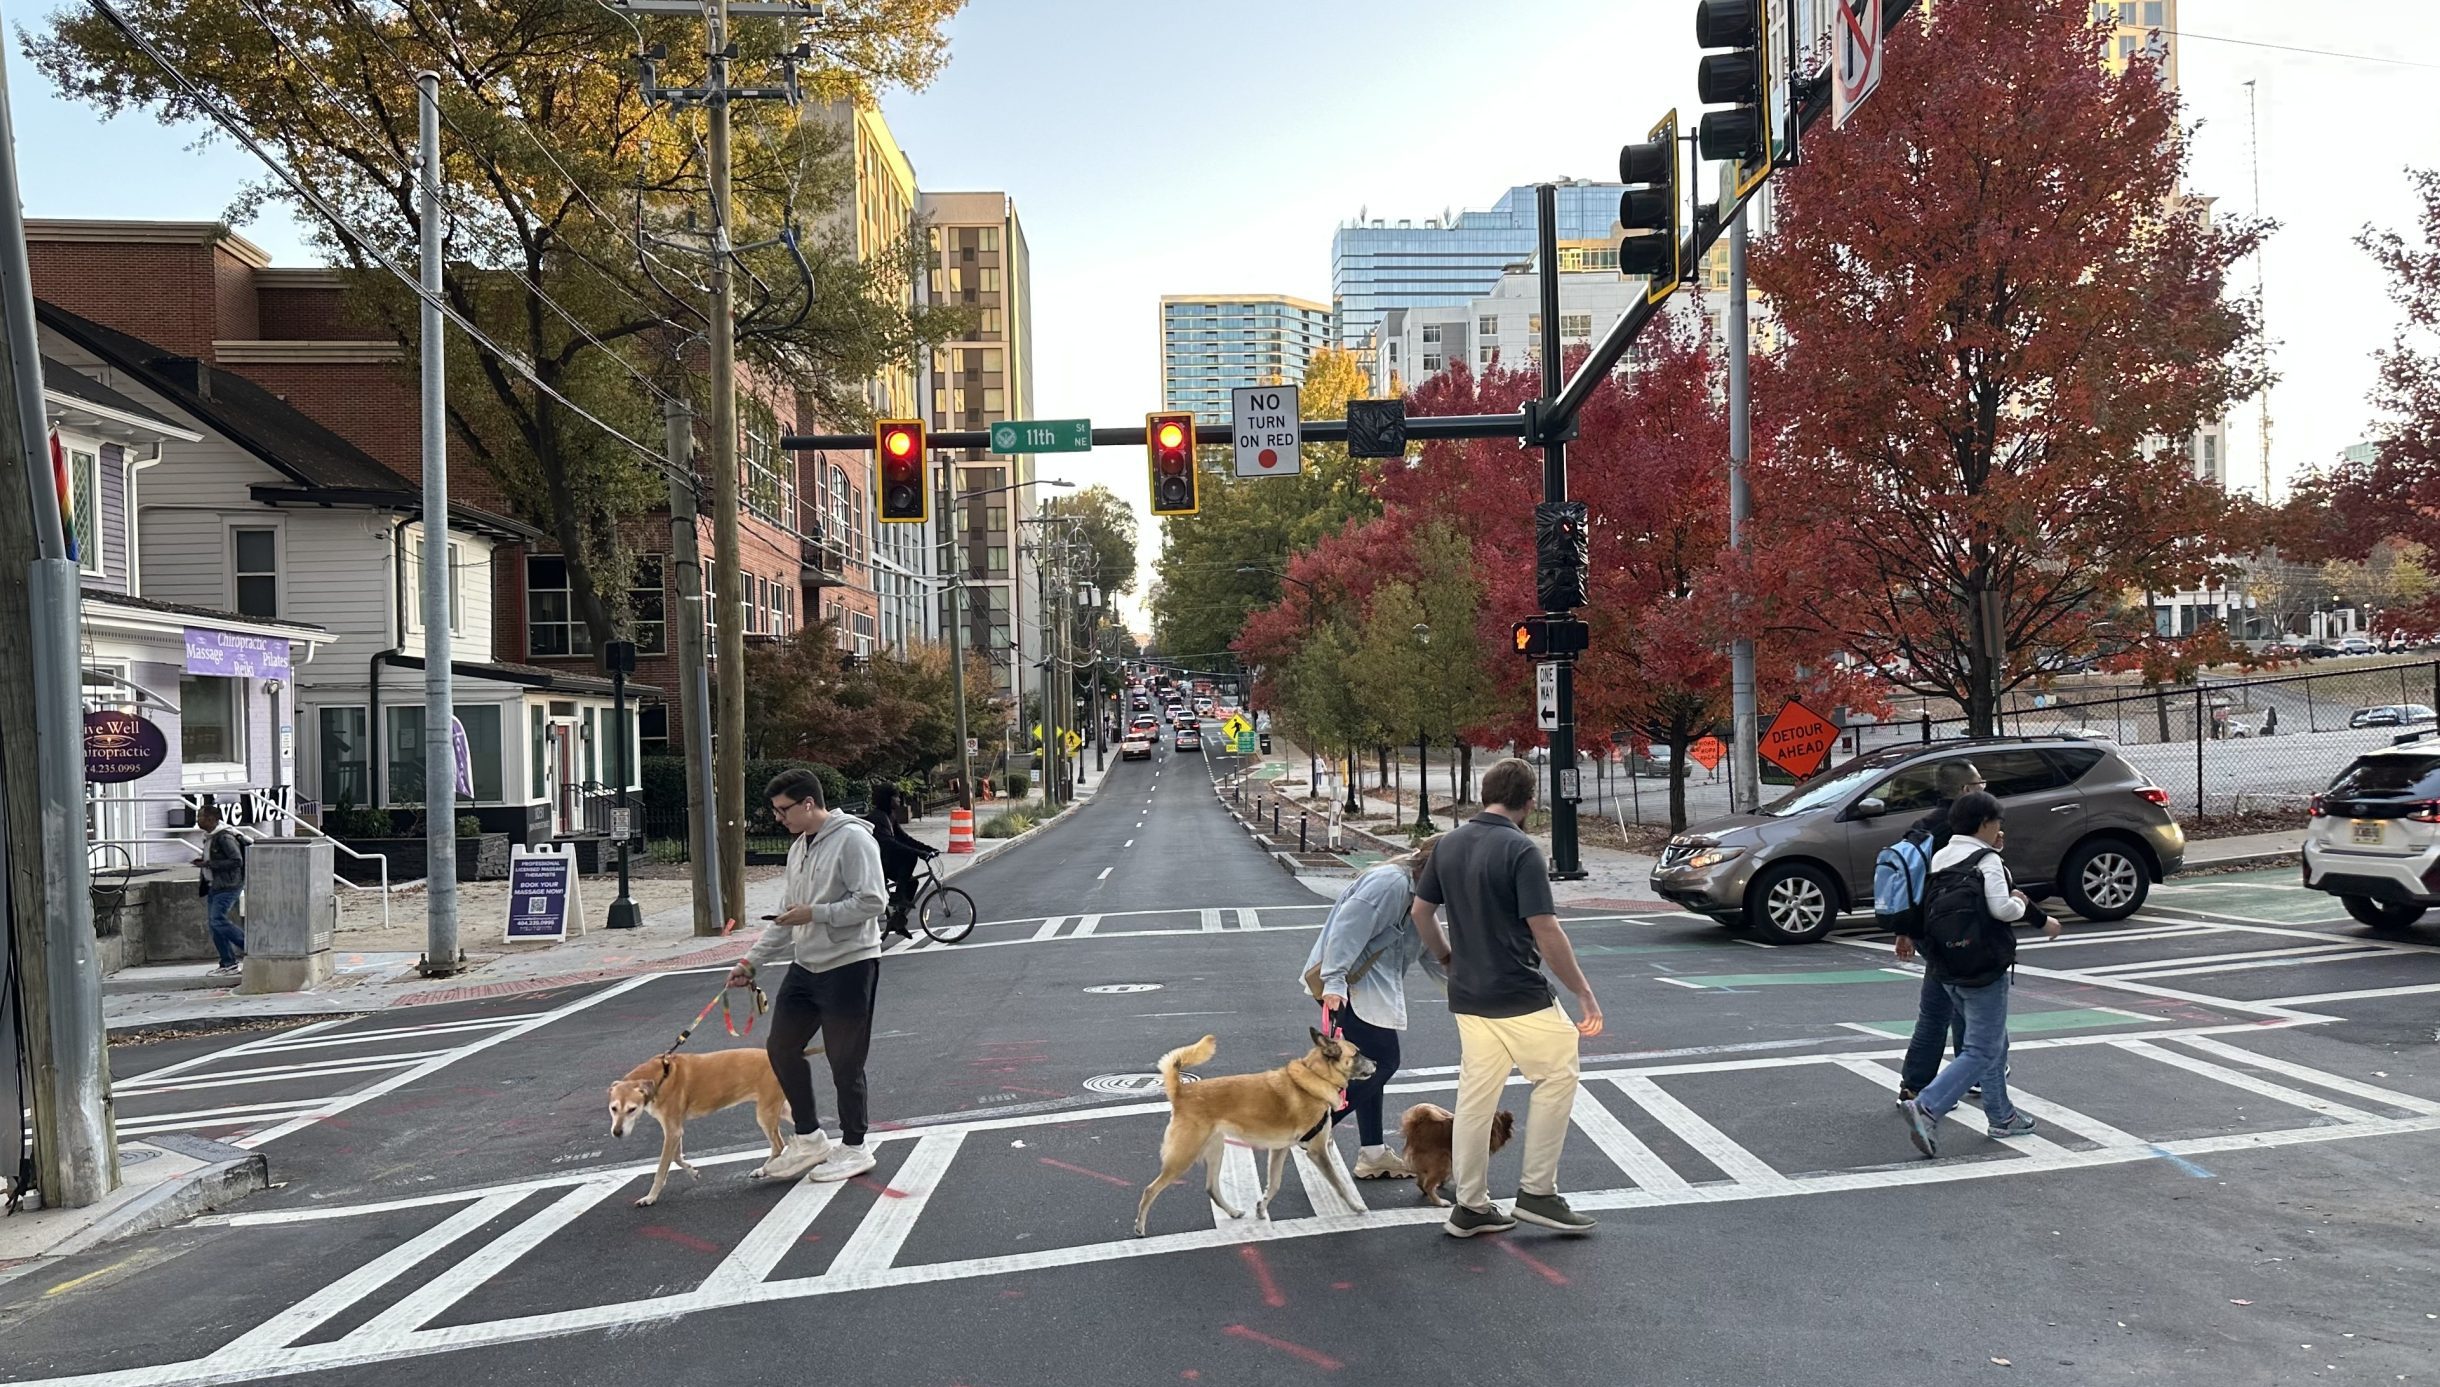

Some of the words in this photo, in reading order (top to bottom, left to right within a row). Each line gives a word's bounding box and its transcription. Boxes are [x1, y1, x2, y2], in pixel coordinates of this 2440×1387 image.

[1250, 393, 1280, 411] NO
[1247, 415, 1286, 430] TURN
[1026, 428, 1055, 446] 11th
[1075, 423, 1085, 433] St
[1074, 437, 1087, 446] NE
[1240, 434, 1259, 448] ON
[1267, 433, 1294, 447] RED
[217, 632, 267, 653] Chiropractic
[186, 643, 224, 665] Massage
[262, 651, 289, 668] Pilates
[233, 661, 255, 677] Reiki
[1540, 667, 1554, 682] ONE
[1540, 686, 1554, 700] WAY
[84, 723, 104, 734] ive
[107, 721, 140, 734] Well
[1772, 722, 1823, 744] DETOUR
[84, 745, 151, 760] iropractic
[1777, 739, 1824, 761] AHEAD
[85, 764, 141, 773] 4.235.0995
[193, 793, 243, 826] Lve
[250, 787, 292, 824] Well
